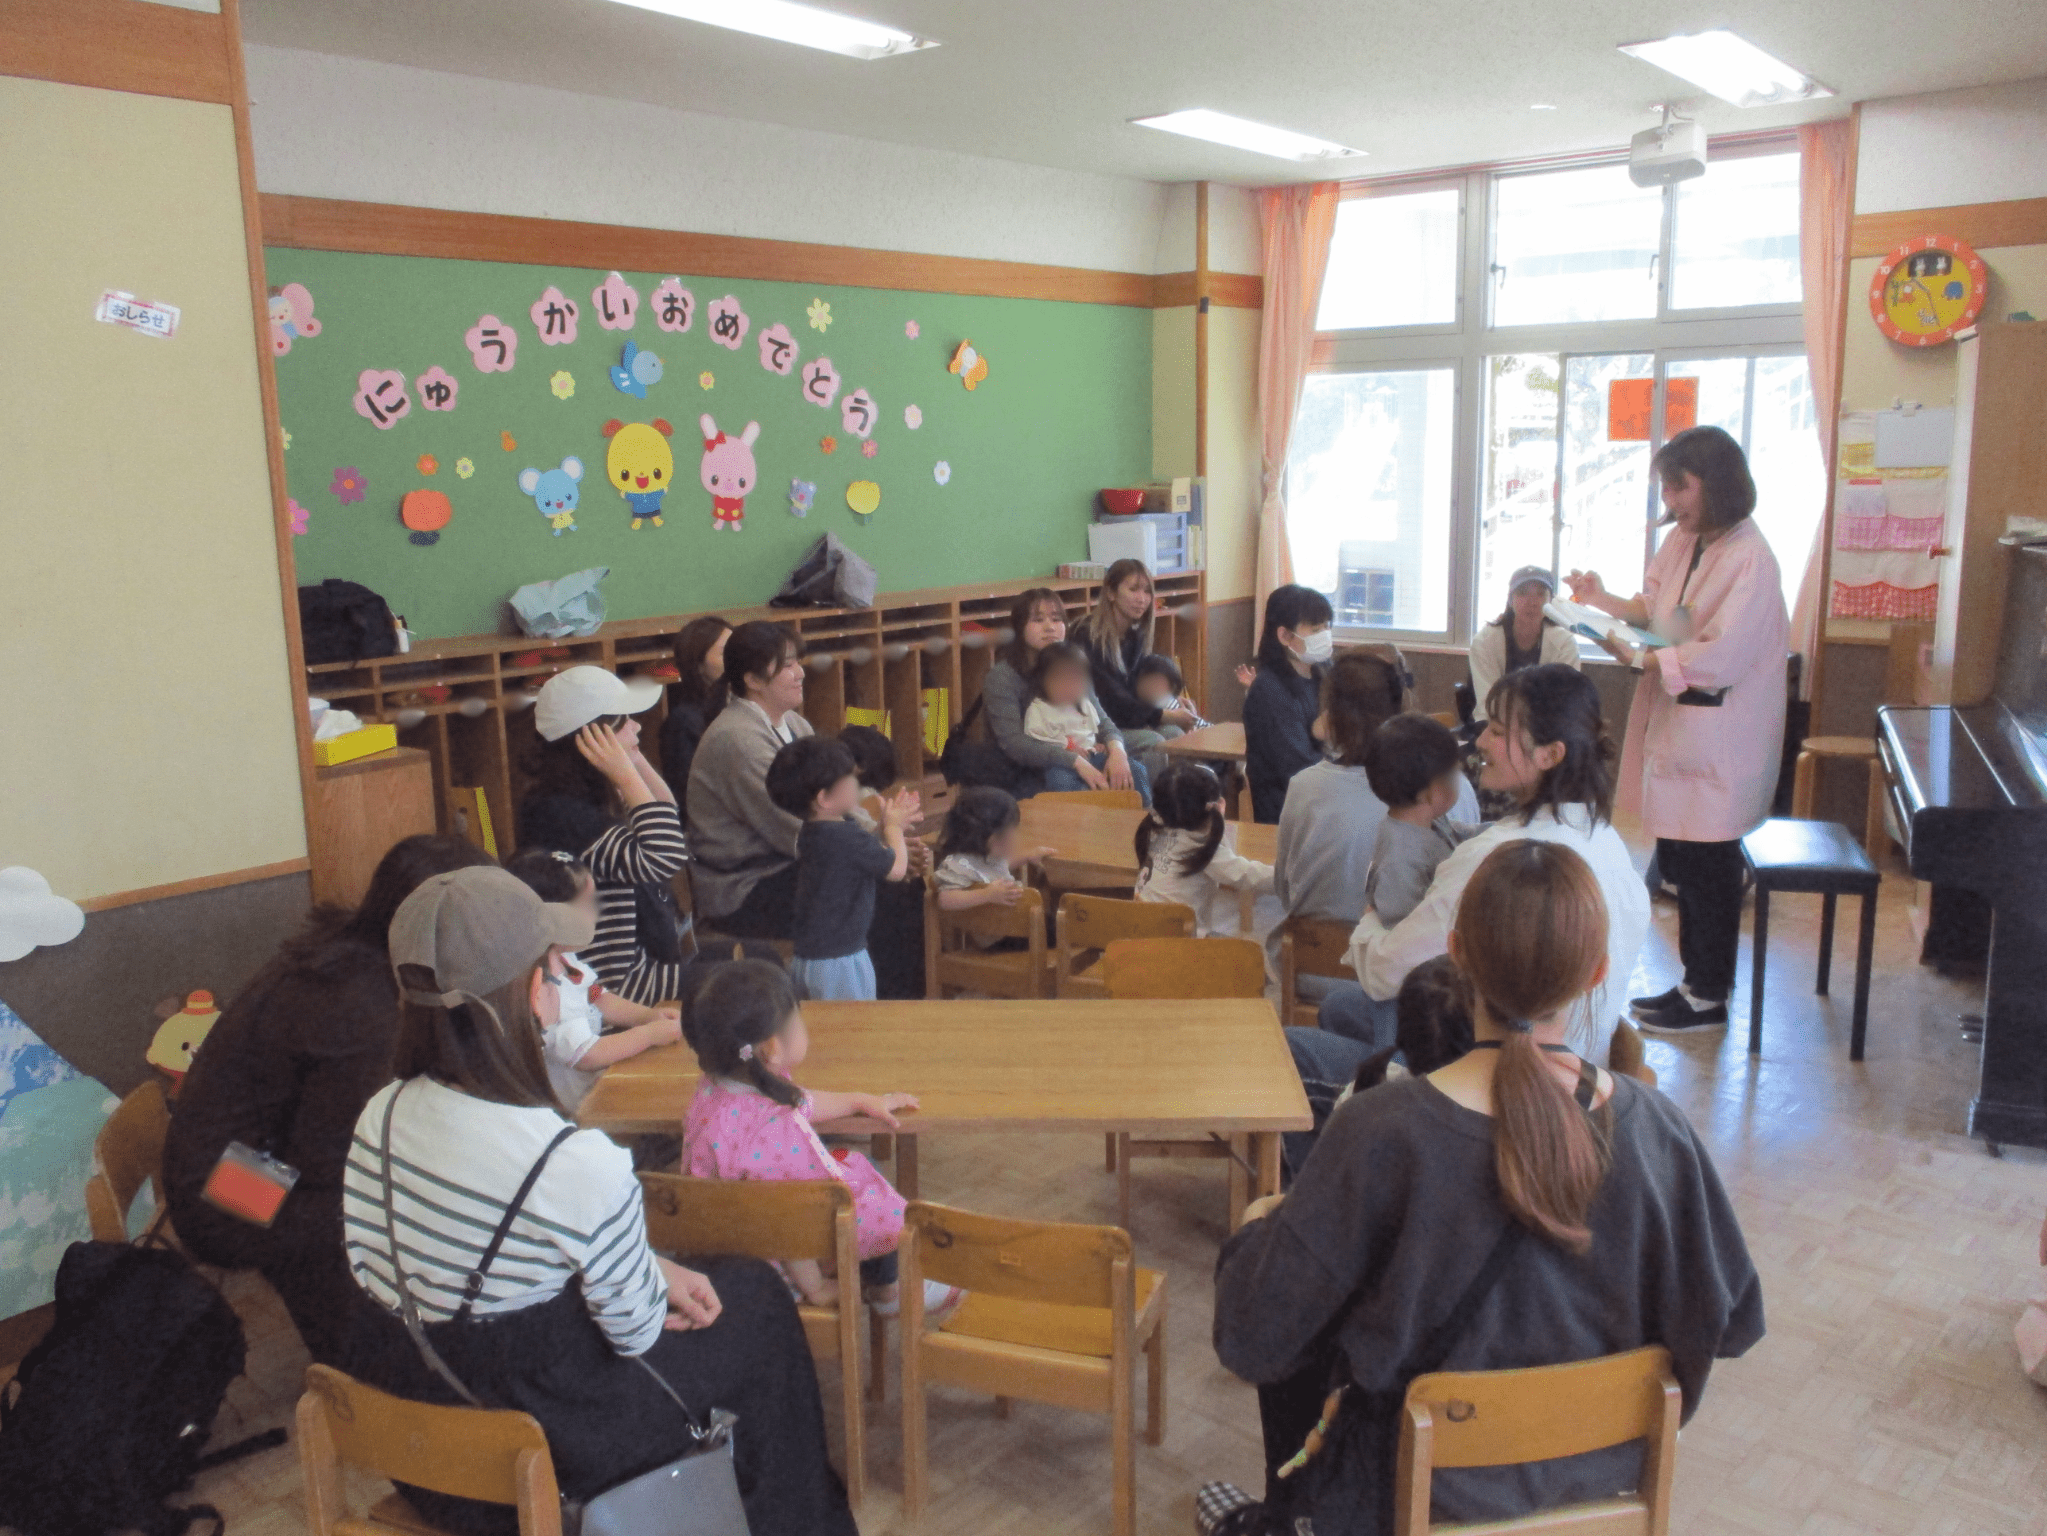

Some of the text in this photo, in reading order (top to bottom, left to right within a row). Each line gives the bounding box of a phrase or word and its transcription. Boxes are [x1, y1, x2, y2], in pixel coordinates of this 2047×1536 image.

[1925, 238, 1936, 247] 12
[1899, 246, 1910, 255] 11
[1880, 265, 1891, 274] 10
[112, 303, 164, 328] おしらせ
